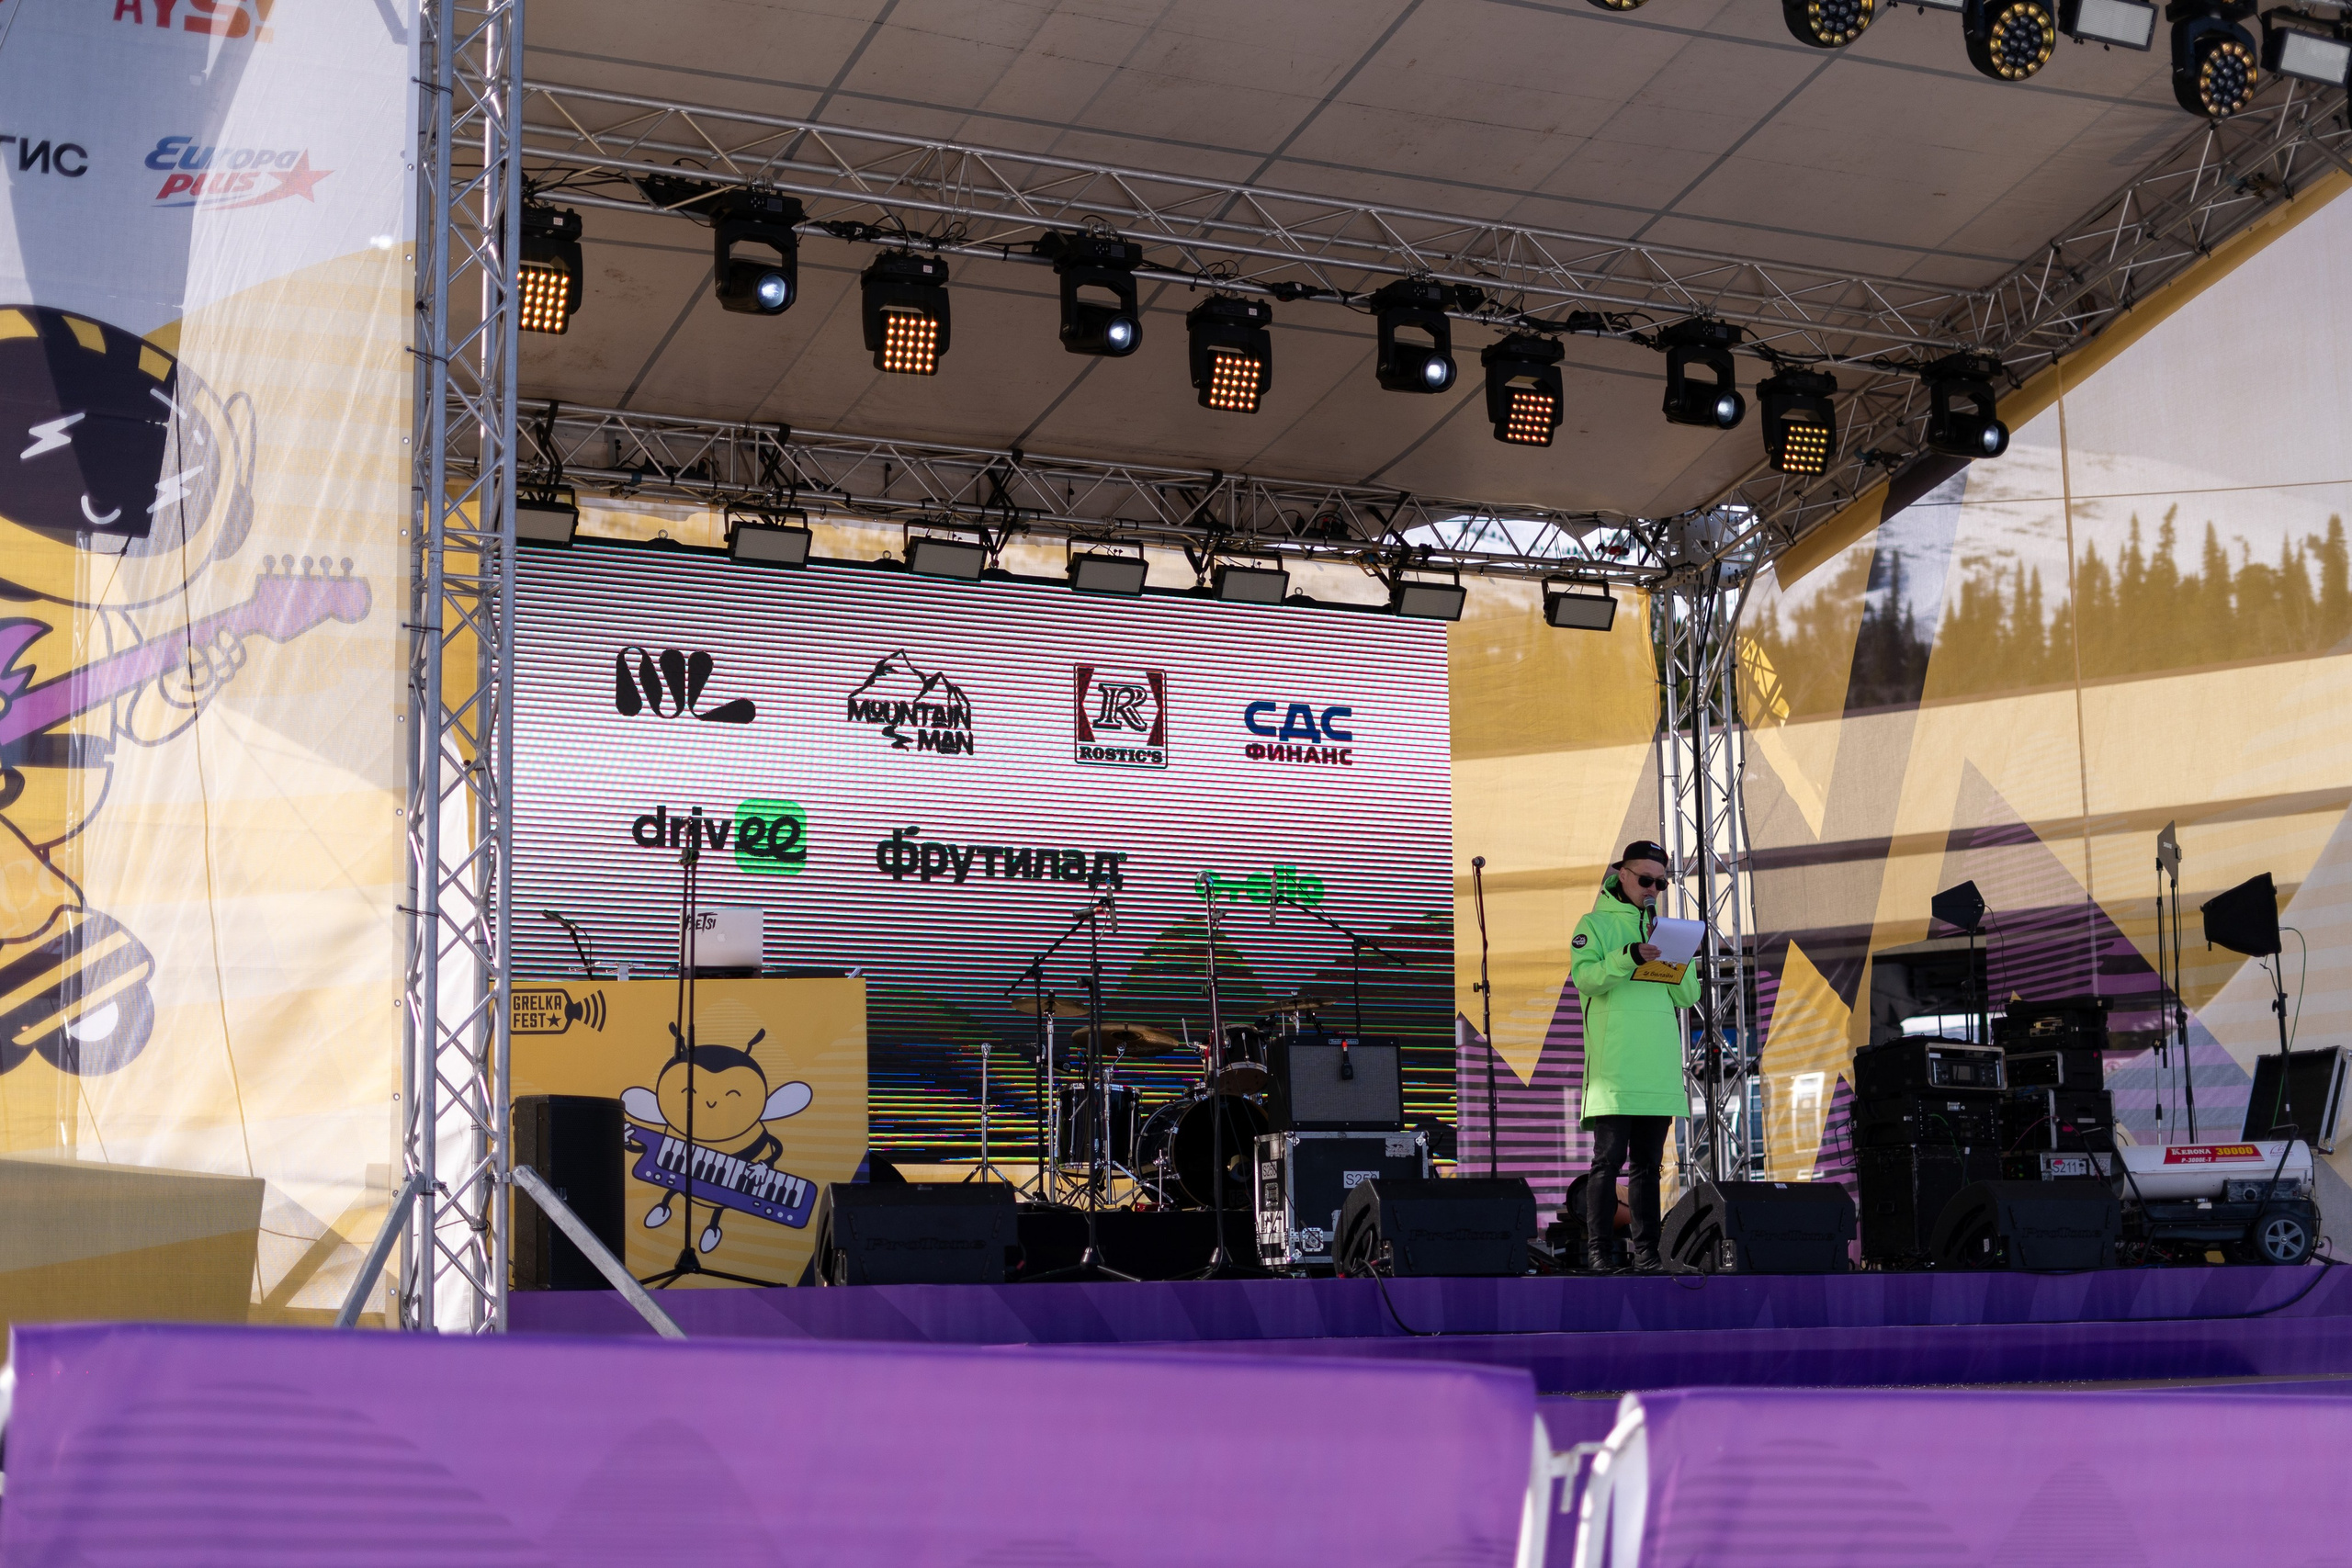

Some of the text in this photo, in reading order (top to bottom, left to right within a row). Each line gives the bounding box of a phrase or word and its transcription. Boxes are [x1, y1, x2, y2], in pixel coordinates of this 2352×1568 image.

[848, 698, 971, 729] MOUNTAIN
[1244, 701, 1352, 743] СДС
[918, 728, 974, 755] MAN
[1079, 745, 1163, 763] ROSTIC'S
[1245, 742, 1353, 766] ФИНАНС
[632, 806, 808, 863] drivee
[876, 827, 1124, 890] фрутилад
[513, 995, 562, 1010] GRELKA
[513, 1012, 546, 1028] FEST
[2216, 1146, 2254, 1156] 30000
